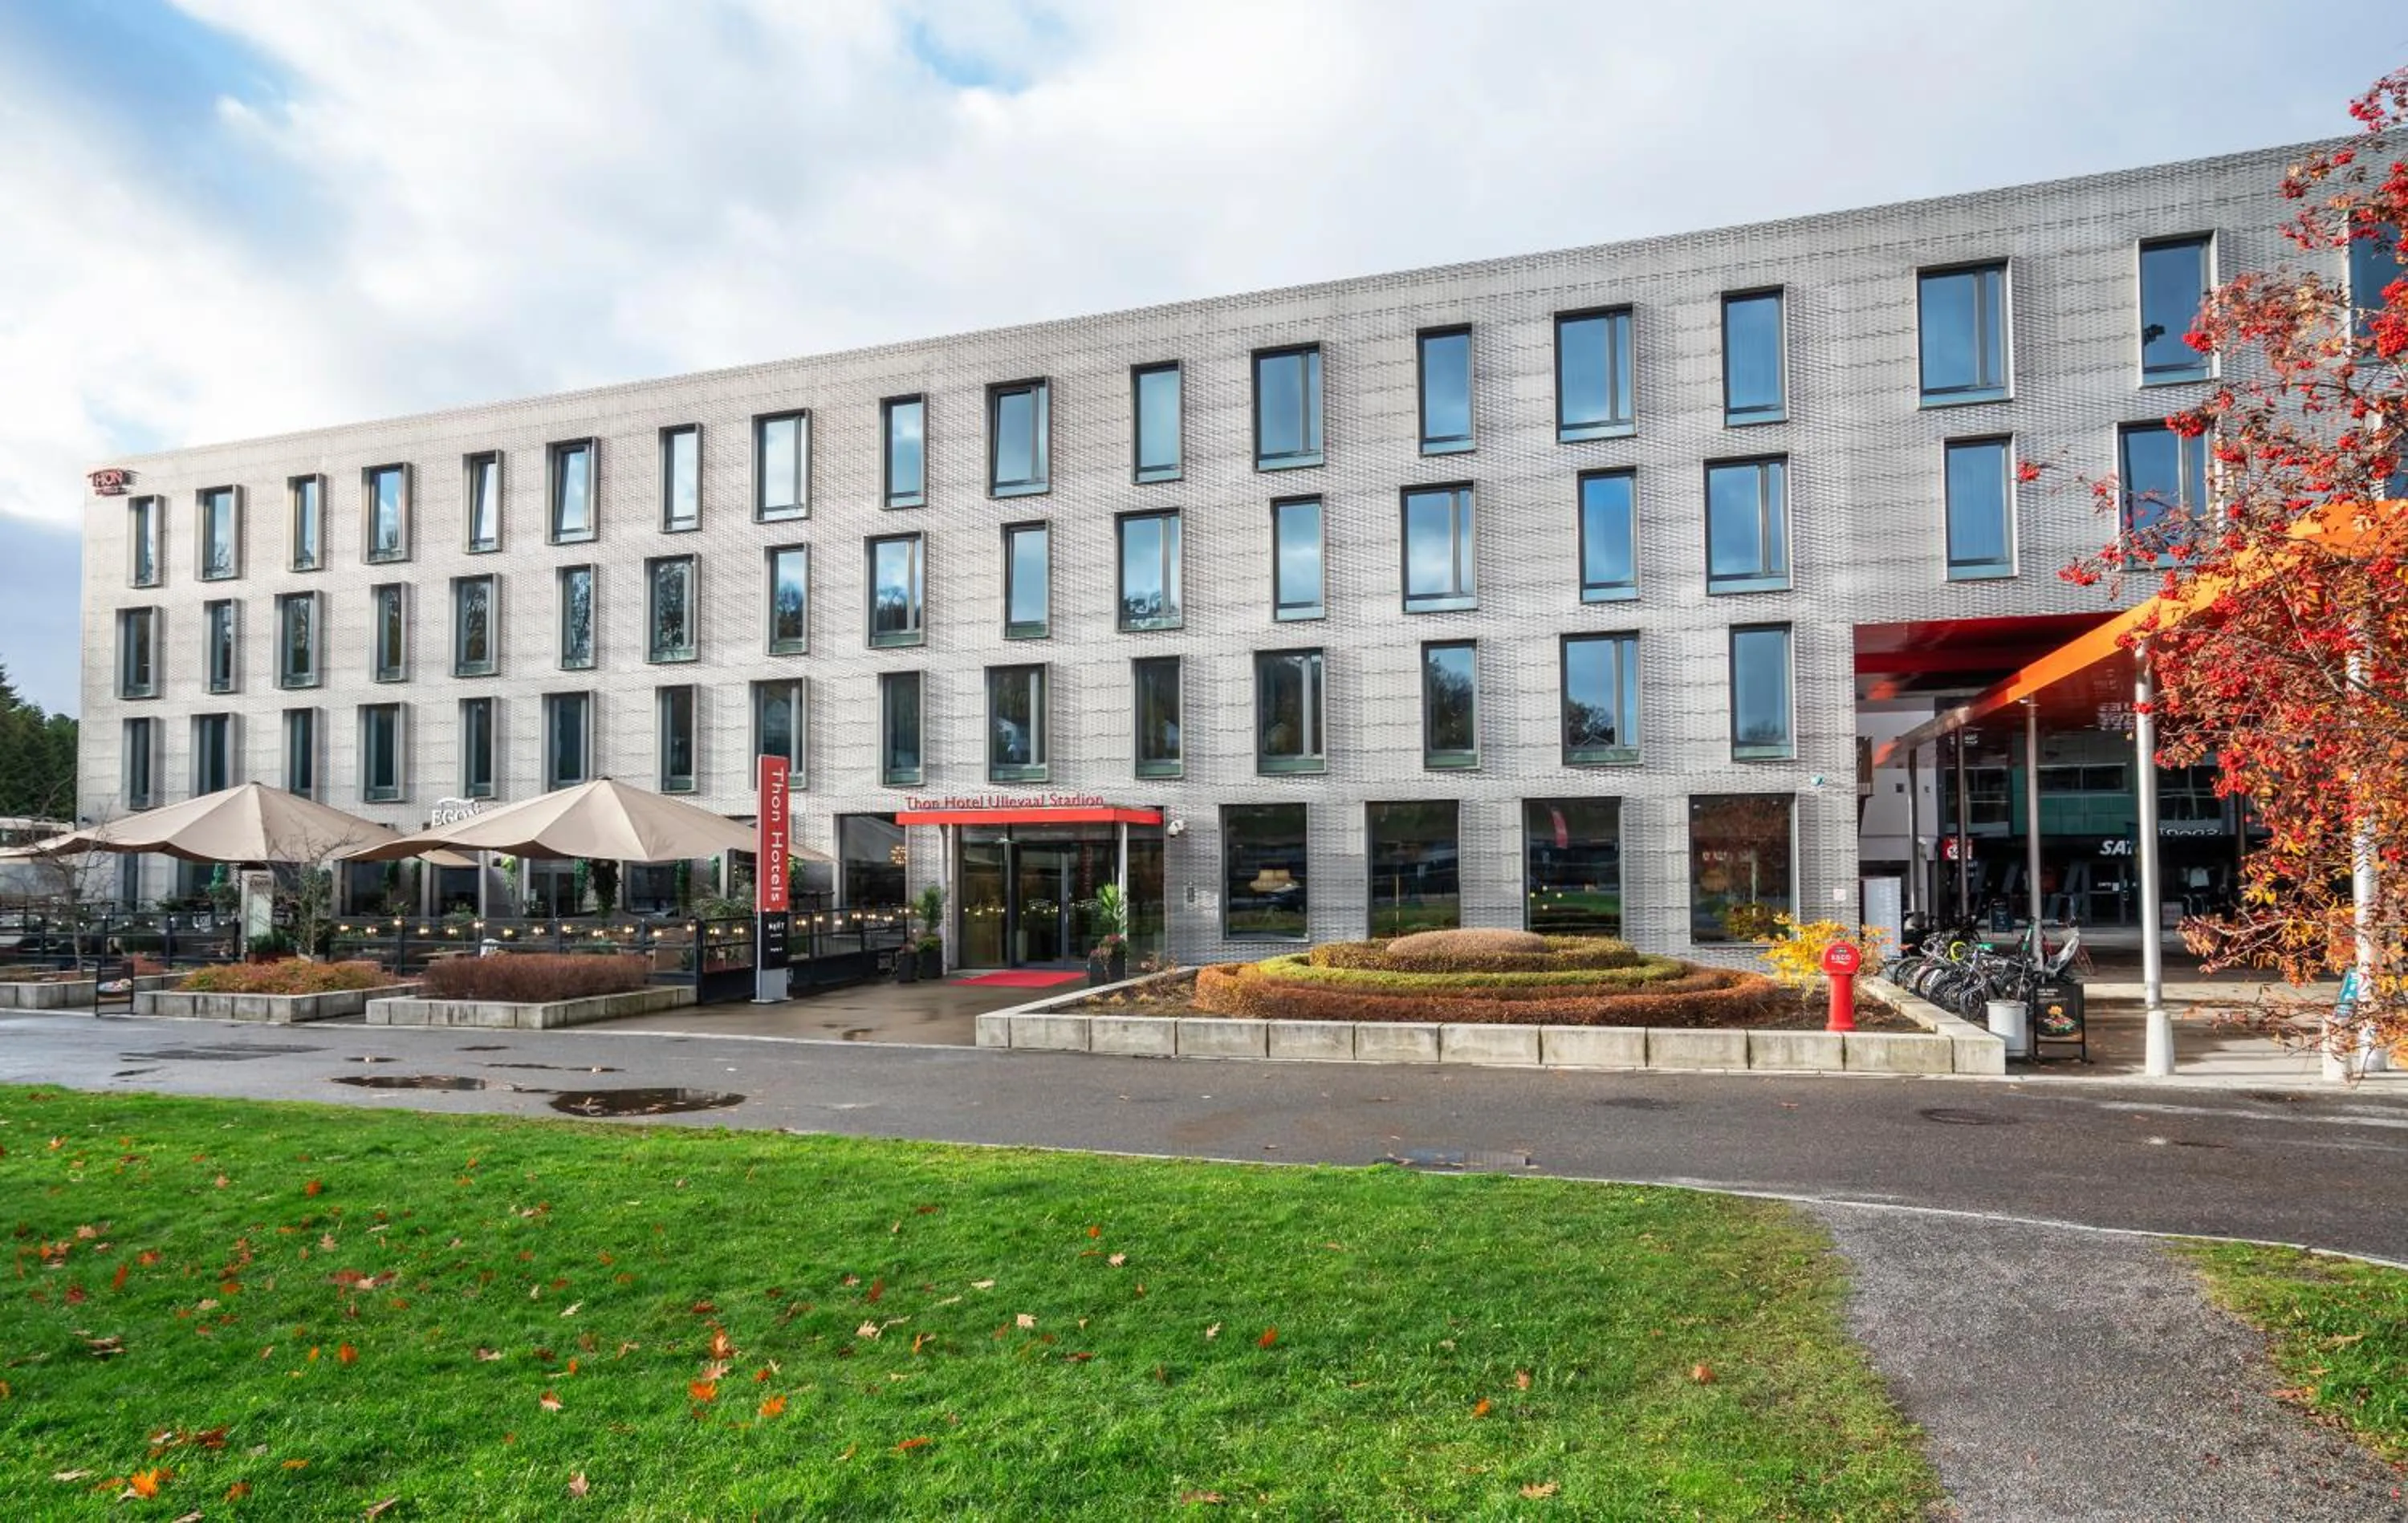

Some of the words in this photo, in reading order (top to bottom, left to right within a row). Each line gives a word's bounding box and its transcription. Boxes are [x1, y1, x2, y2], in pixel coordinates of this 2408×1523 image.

[771, 767, 784, 822] Thon
[905, 796, 939, 810] Thon
[945, 795, 983, 809] Hotel
[987, 794, 1044, 808] Ullevaal
[1049, 791, 1104, 806] Stadion
[771, 831, 783, 902] Hotels
